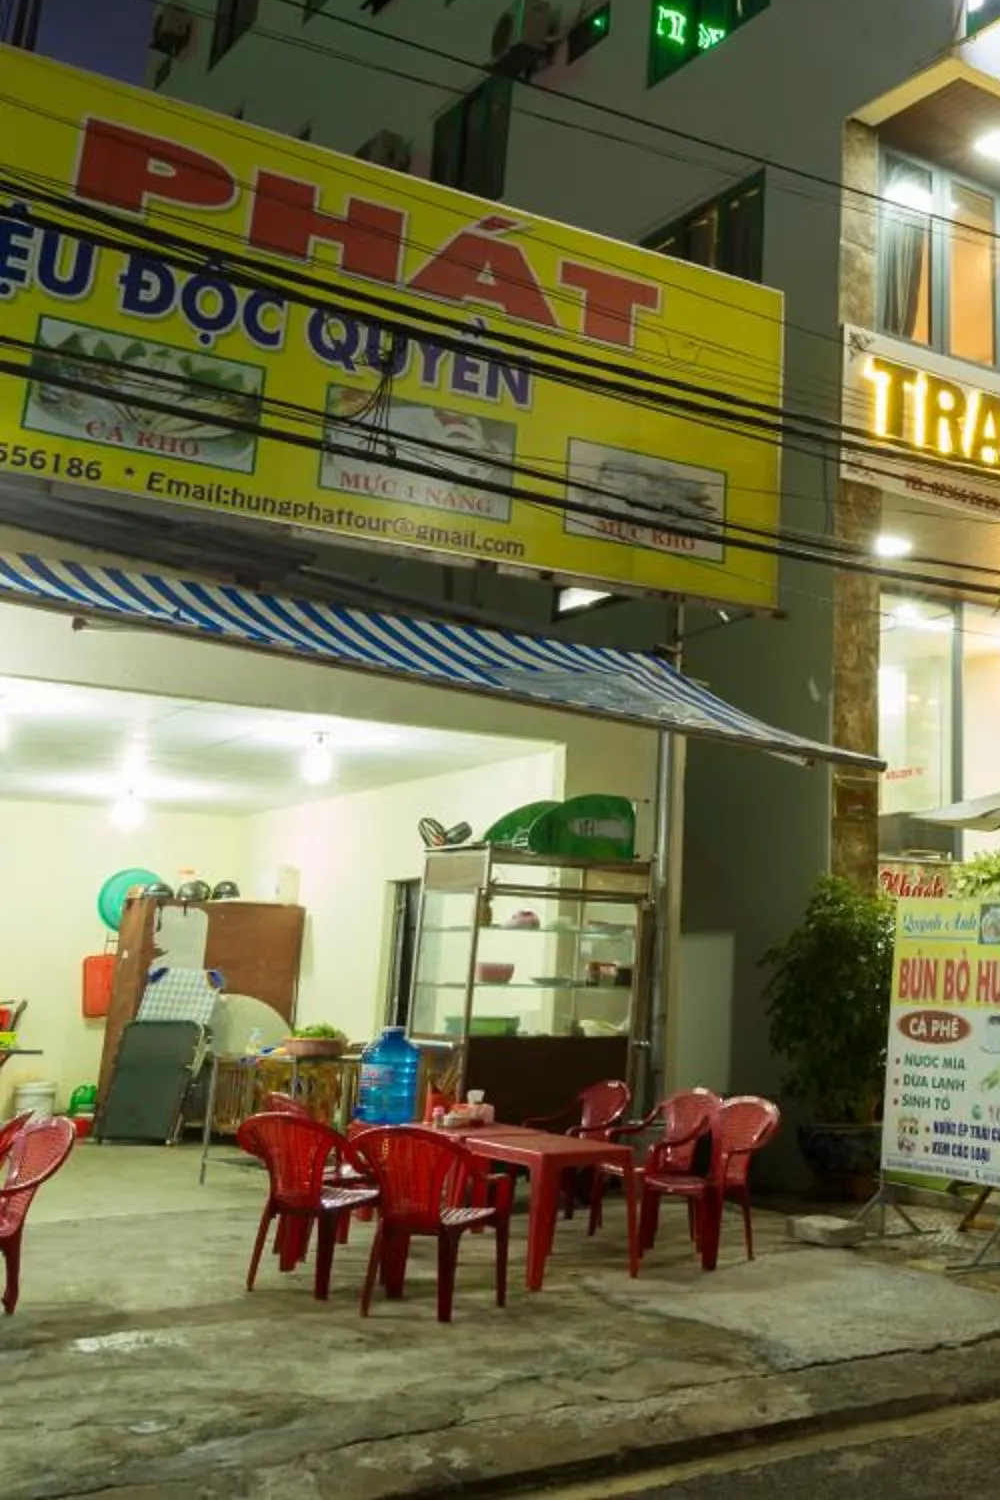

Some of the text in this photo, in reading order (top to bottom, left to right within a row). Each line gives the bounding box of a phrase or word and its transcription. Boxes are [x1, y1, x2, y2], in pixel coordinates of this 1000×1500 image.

[73, 115, 662, 352] PHÁT
[898, 948, 938, 1000] BÚN
[943, 948, 971, 1001] BÒ
